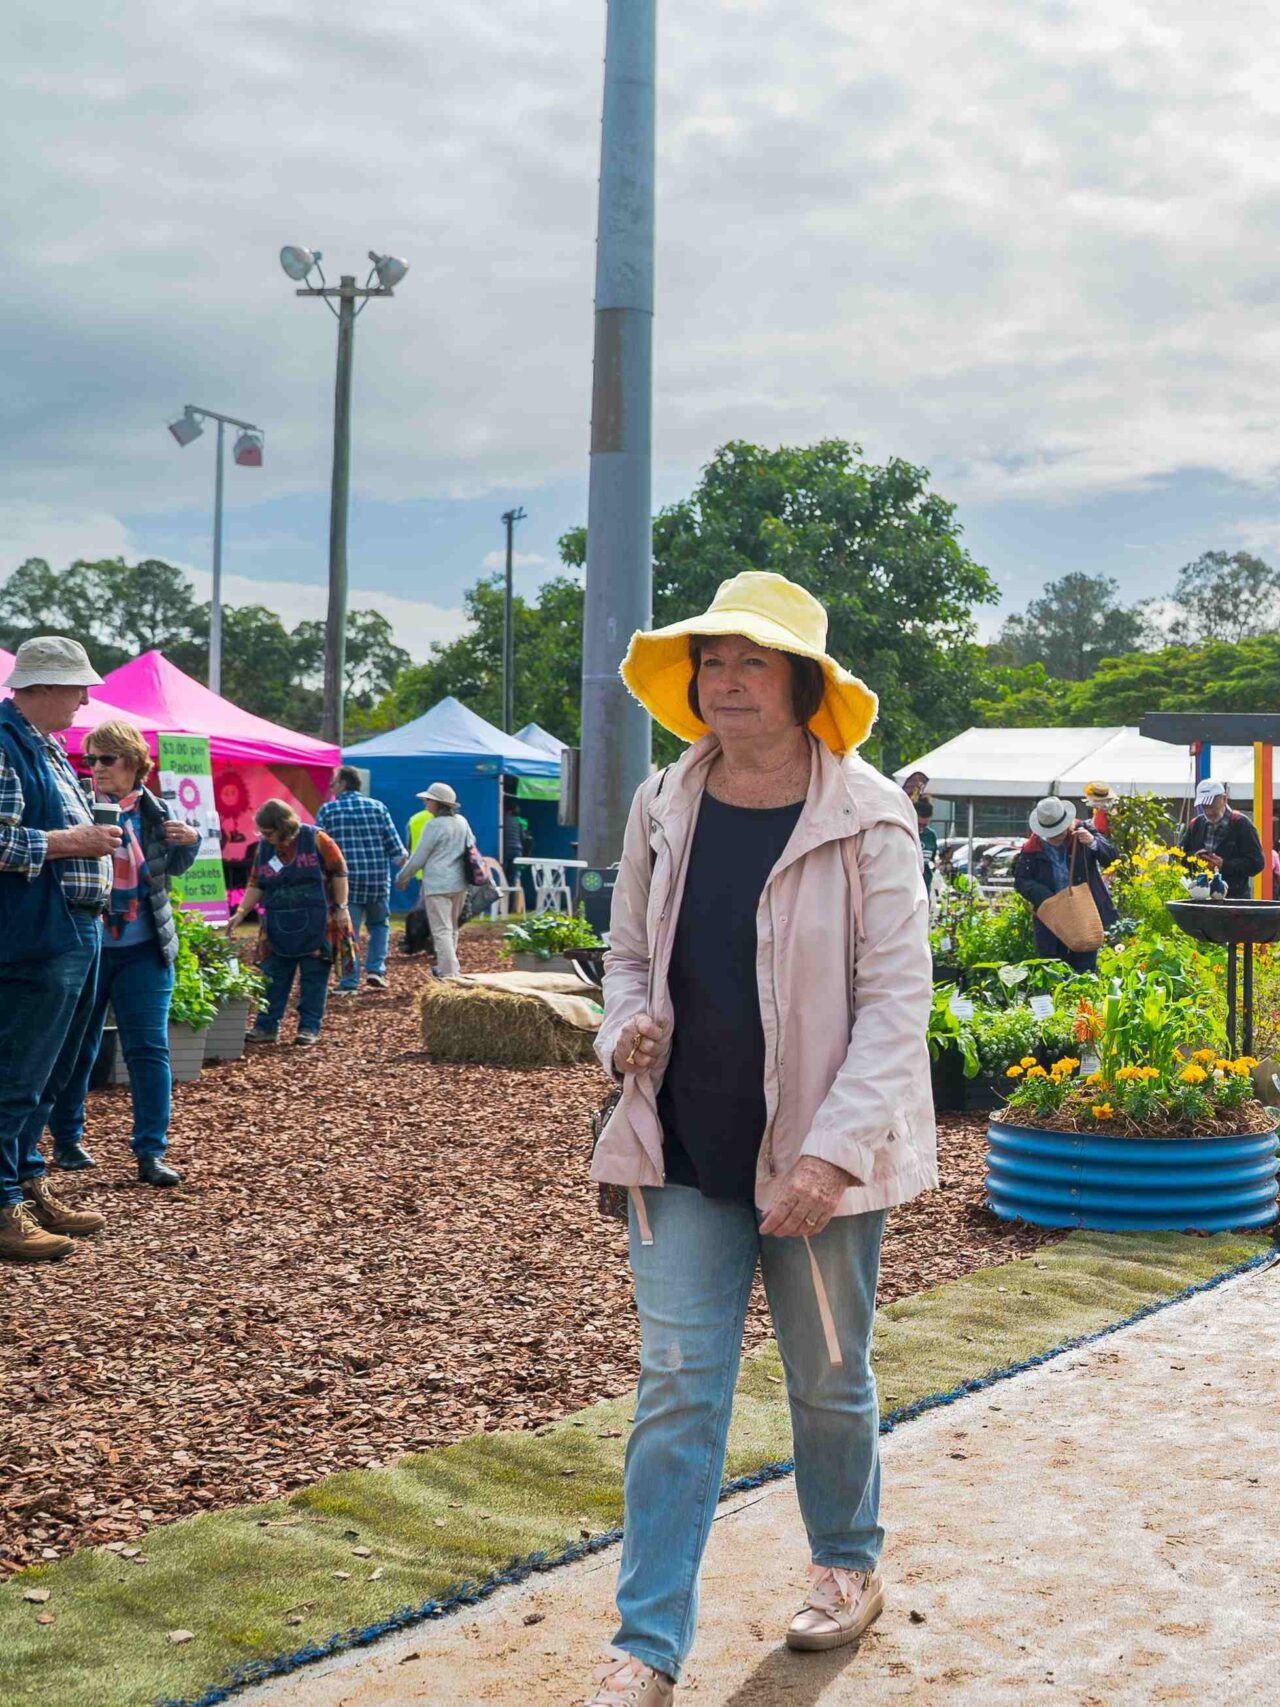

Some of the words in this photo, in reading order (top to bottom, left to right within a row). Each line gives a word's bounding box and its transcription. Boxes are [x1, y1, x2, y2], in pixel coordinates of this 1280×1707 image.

[190, 745, 205, 758] per
[185, 867, 222, 881] packets
[184, 884, 198, 897] for
[200, 883, 217, 896] $20
